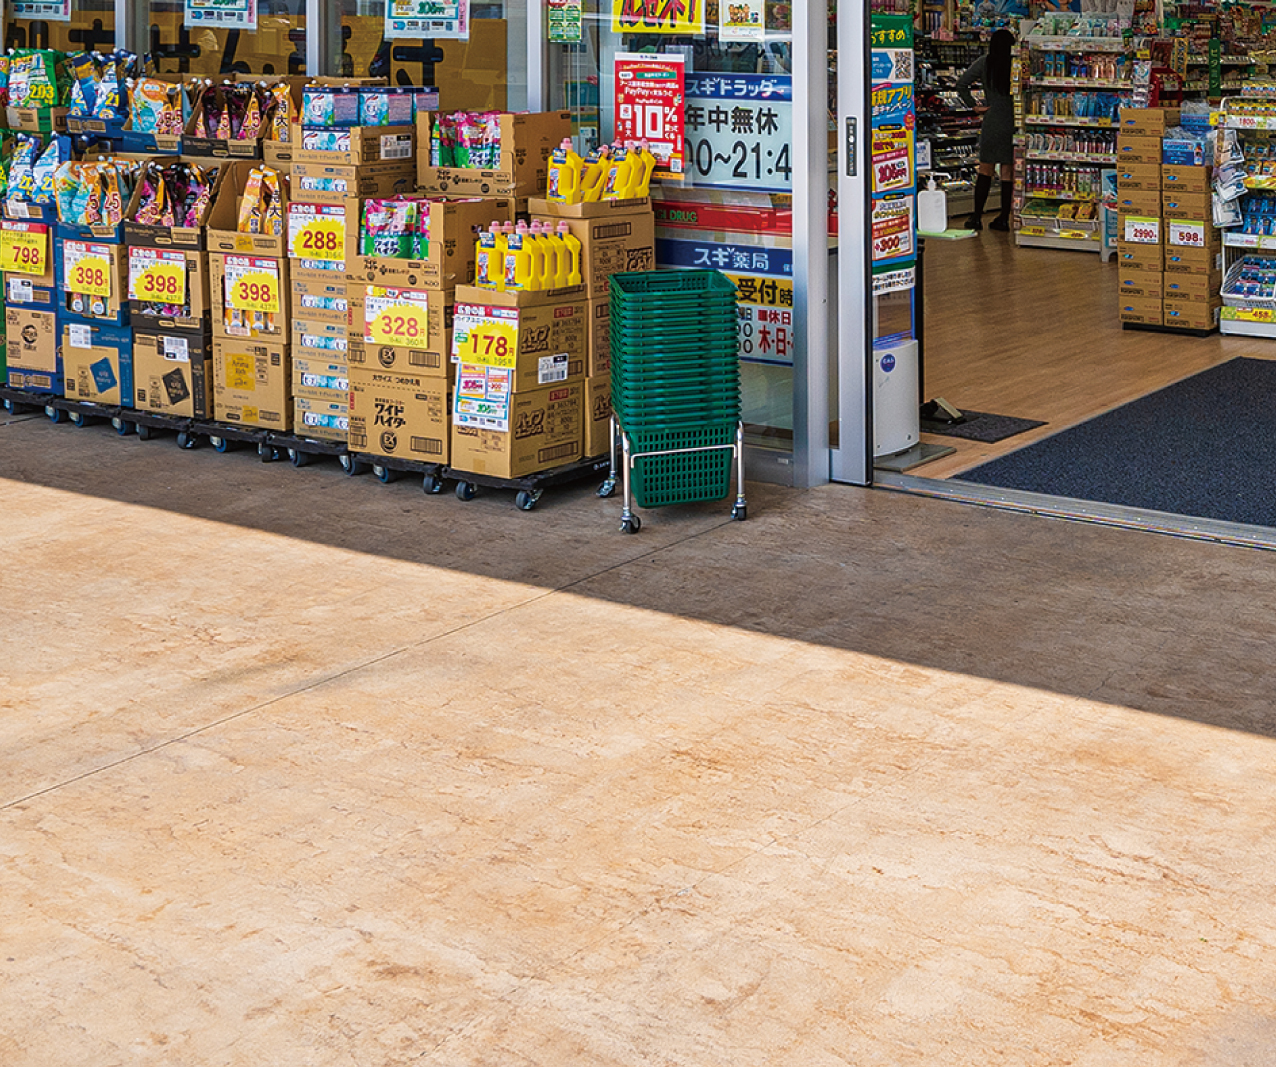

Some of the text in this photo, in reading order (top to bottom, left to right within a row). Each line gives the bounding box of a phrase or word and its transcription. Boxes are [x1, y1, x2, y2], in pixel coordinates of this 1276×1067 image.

[684, 104, 778, 136] 年中無休
[693, 246, 769, 272] スギ薬局
[374, 403, 405, 415] ワイド
